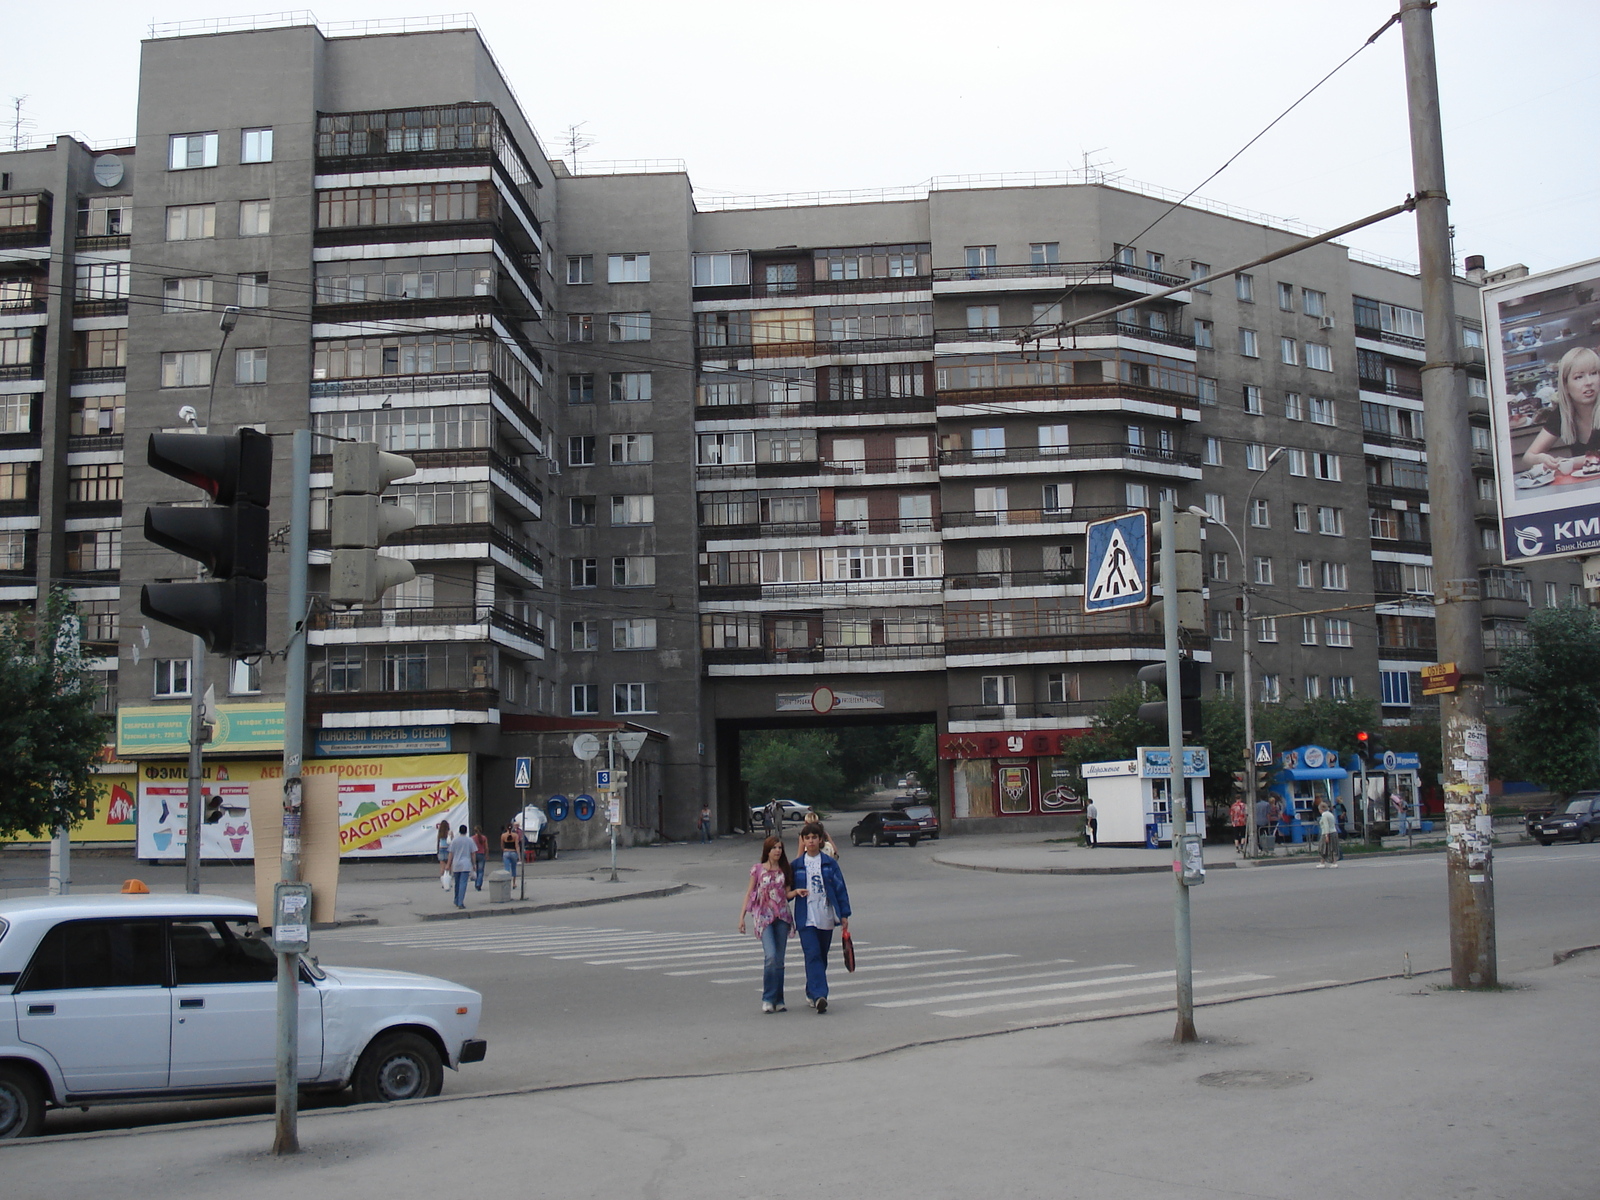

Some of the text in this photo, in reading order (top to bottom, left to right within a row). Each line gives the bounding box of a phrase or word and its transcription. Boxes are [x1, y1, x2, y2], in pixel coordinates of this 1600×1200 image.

[1555, 543, 1576, 552] Банк
[1427, 665, 1447, 676] ОБУВЬ
[319, 727, 447, 741] ЛИНОЛЕУМ КАФЕЛЬ СТЕКЛО
[329, 764, 384, 777] ПРОСТО!
[602, 773, 608, 782] 3
[339, 785, 459, 845] РАСПРОДАЖА
